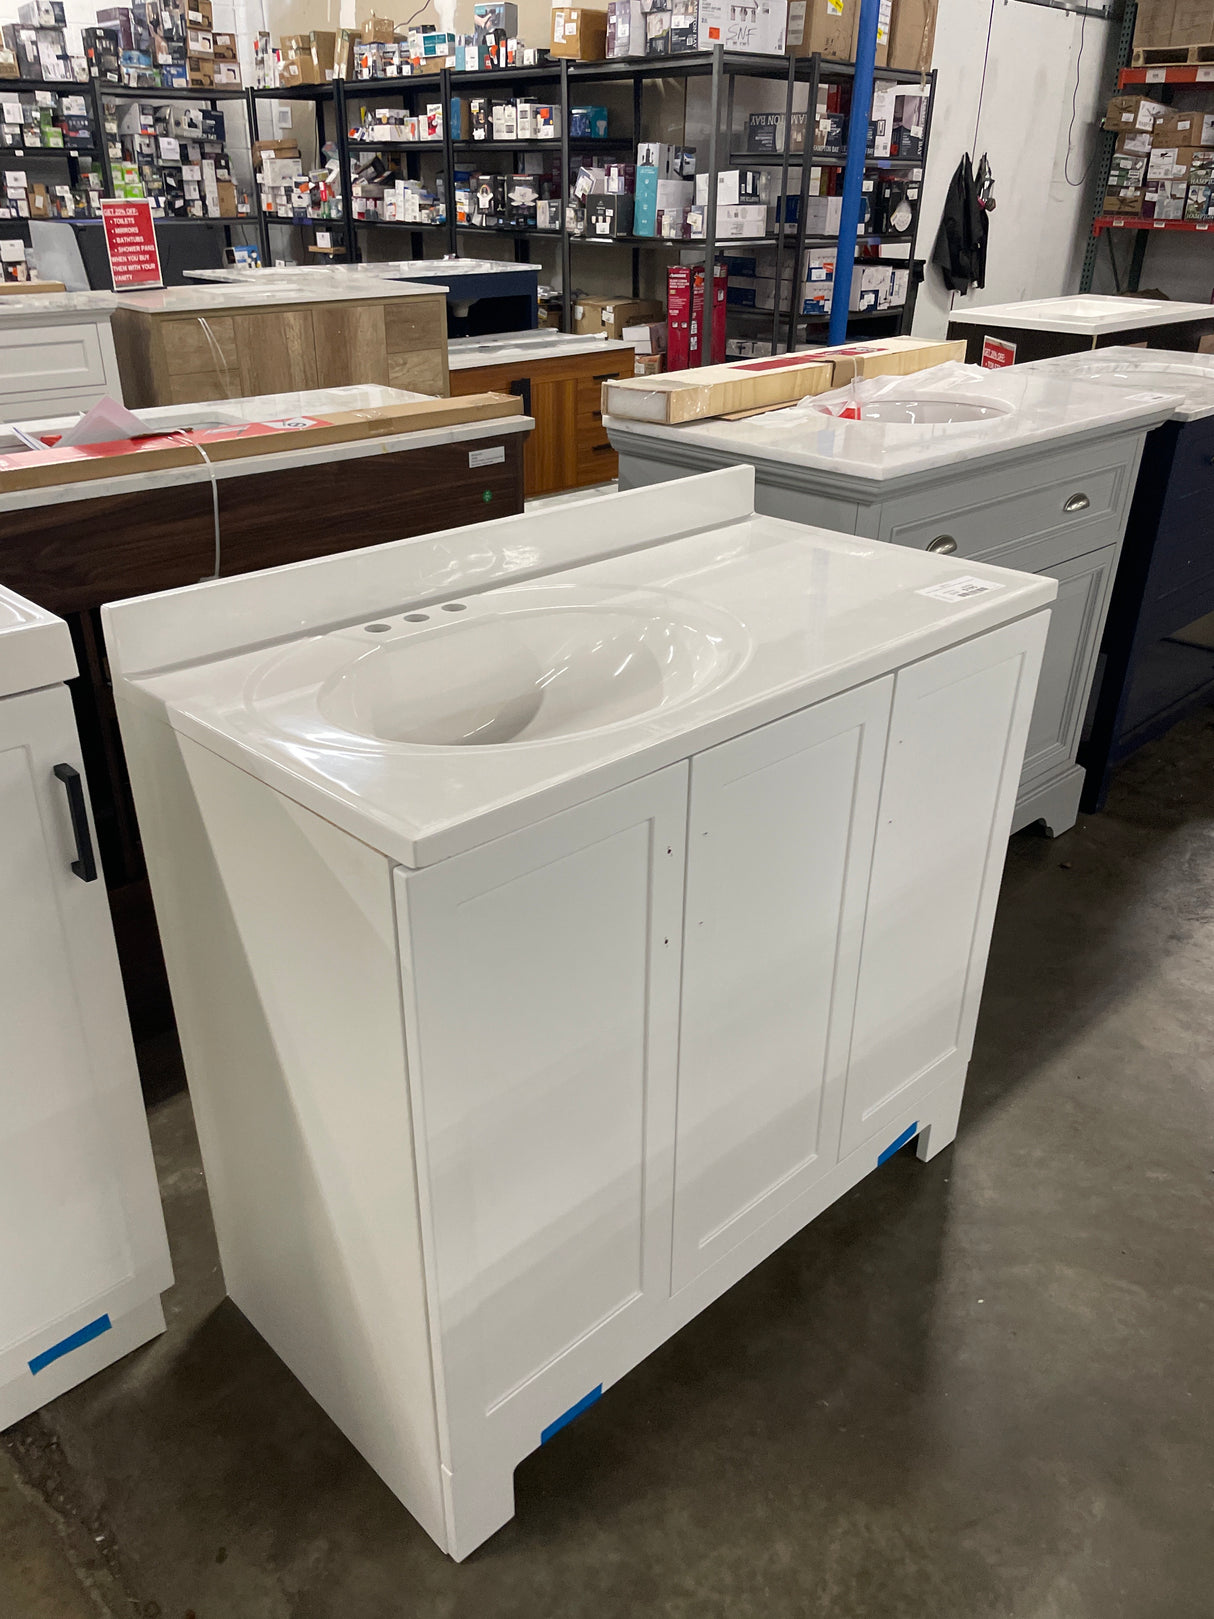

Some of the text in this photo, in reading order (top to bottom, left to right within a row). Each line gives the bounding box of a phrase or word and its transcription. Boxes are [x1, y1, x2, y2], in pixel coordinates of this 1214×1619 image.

[726, 23, 758, 47] SNF
[750, 114, 808, 126] AMTON BAY
[114, 217, 135, 225] TOILETS
[118, 244, 155, 253] SHOWER PANS
[128, 254, 138, 262] YOU
